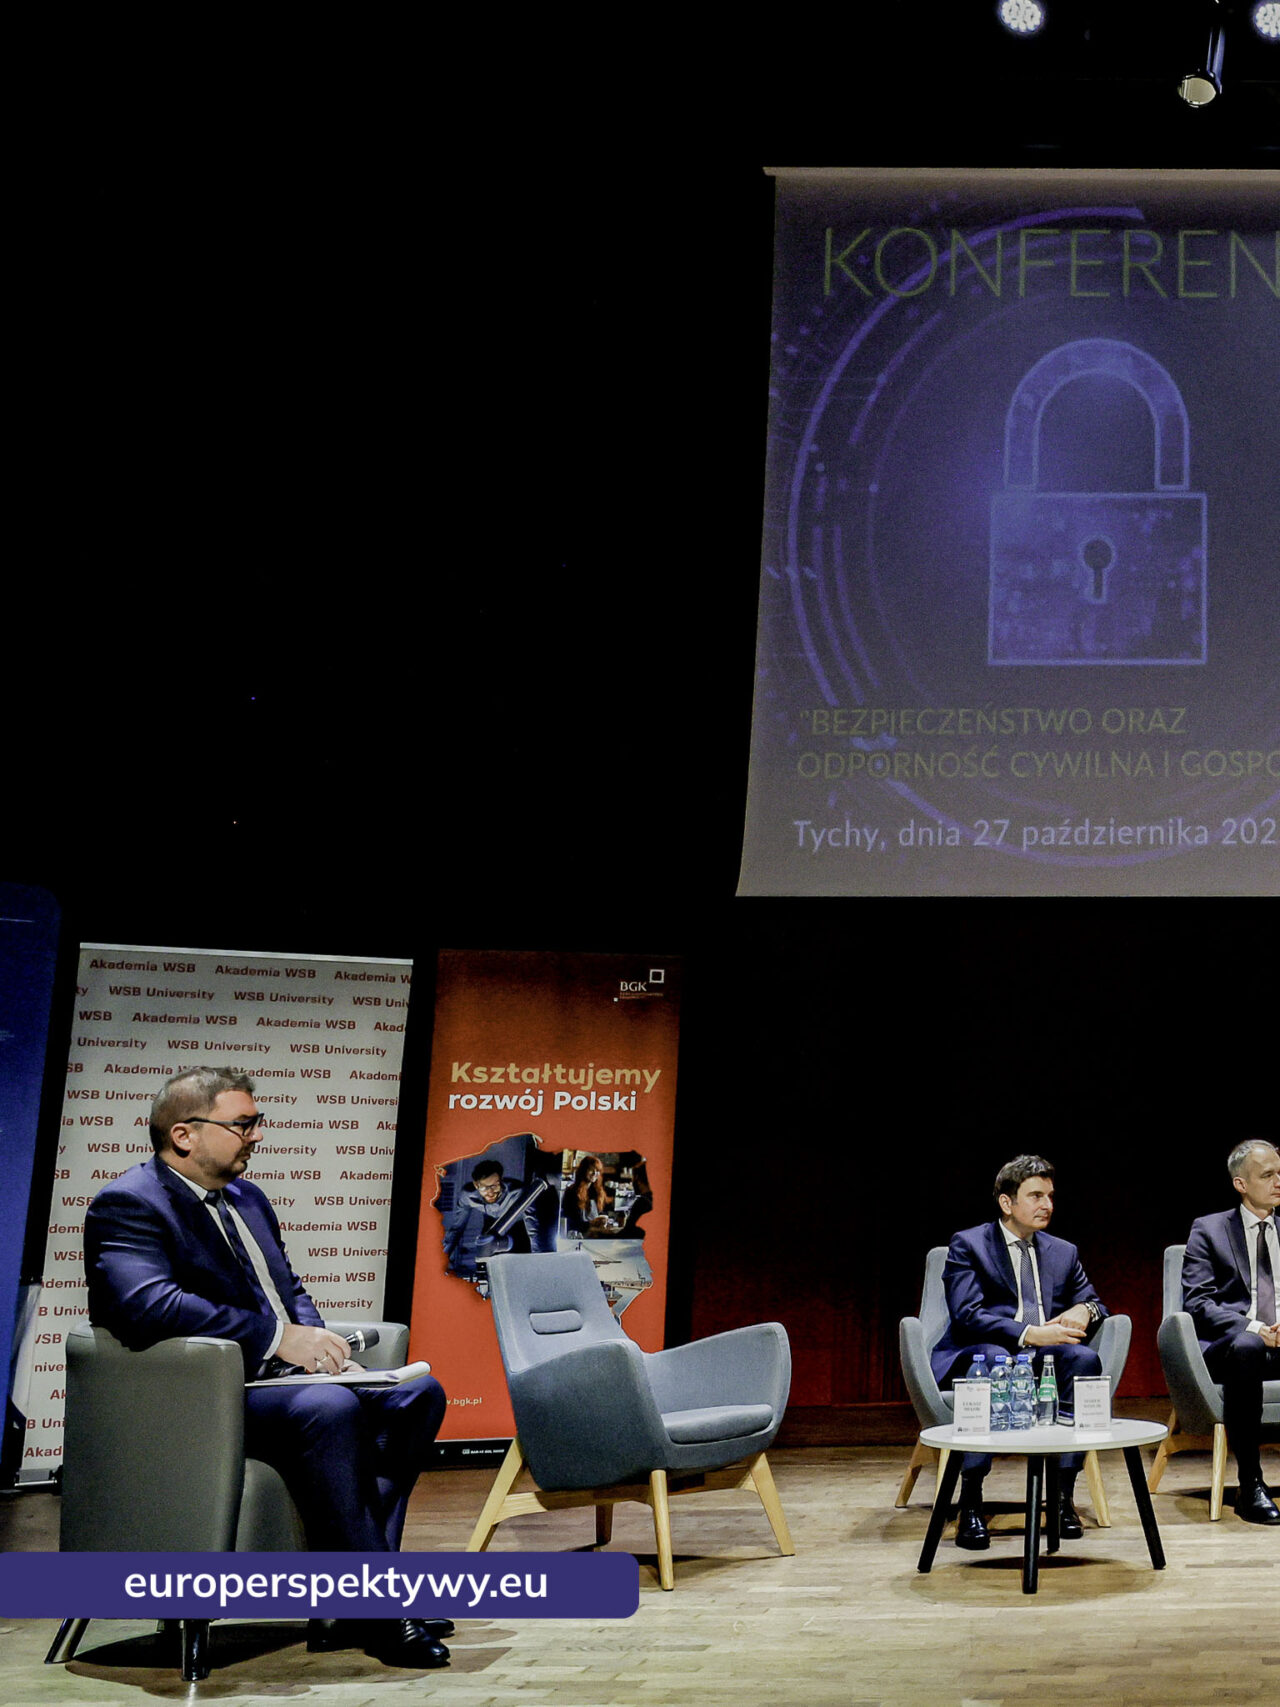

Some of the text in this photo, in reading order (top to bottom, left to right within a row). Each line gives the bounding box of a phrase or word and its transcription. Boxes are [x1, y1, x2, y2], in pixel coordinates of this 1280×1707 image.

[801, 704, 1187, 737] "BEZPIECZEŃSTWO ORAZ
[799, 746, 1001, 779] ODPORNOŚĆ
[1010, 751, 1154, 777] CYWILNA
[1164, 752, 1170, 777] I
[794, 821, 887, 851] Tychy,
[899, 819, 961, 847] dnia
[973, 820, 1010, 846] 27
[1021, 817, 1209, 851] października
[90, 960, 196, 972] Akademia WSB
[215, 965, 316, 978] Akademia WSB
[334, 971, 396, 983] Akademia
[620, 981, 647, 992] BGK
[109, 986, 214, 1000] WSB University
[234, 992, 334, 1006] WSB University
[352, 996, 381, 1006] WSB
[79, 1011, 112, 1021] WSB
[132, 1012, 237, 1025] Akademia WSB
[256, 1017, 356, 1029] Akademia WSB
[78, 1037, 147, 1050] University
[168, 1040, 270, 1053] WSB University
[290, 1044, 386, 1057] WSB University
[104, 1064, 173, 1074] Akademia
[301, 1069, 331, 1079] WSB
[451, 1061, 662, 1093] Kształtujemy
[67, 1090, 99, 1099] WSB
[317, 1095, 346, 1104] WSB
[448, 1088, 637, 1116] rozwój Polski
[80, 1116, 113, 1126] WSB
[259, 1119, 359, 1129] Akademia WSB
[88, 1143, 120, 1153] WSB
[253, 1145, 317, 1156] University
[336, 1146, 365, 1155] WSB
[291, 1170, 321, 1180] WSB
[315, 1196, 343, 1206] WSB
[280, 1221, 377, 1231] Akademia WSB
[308, 1248, 338, 1257] WSB
[346, 1272, 375, 1282] WSB
